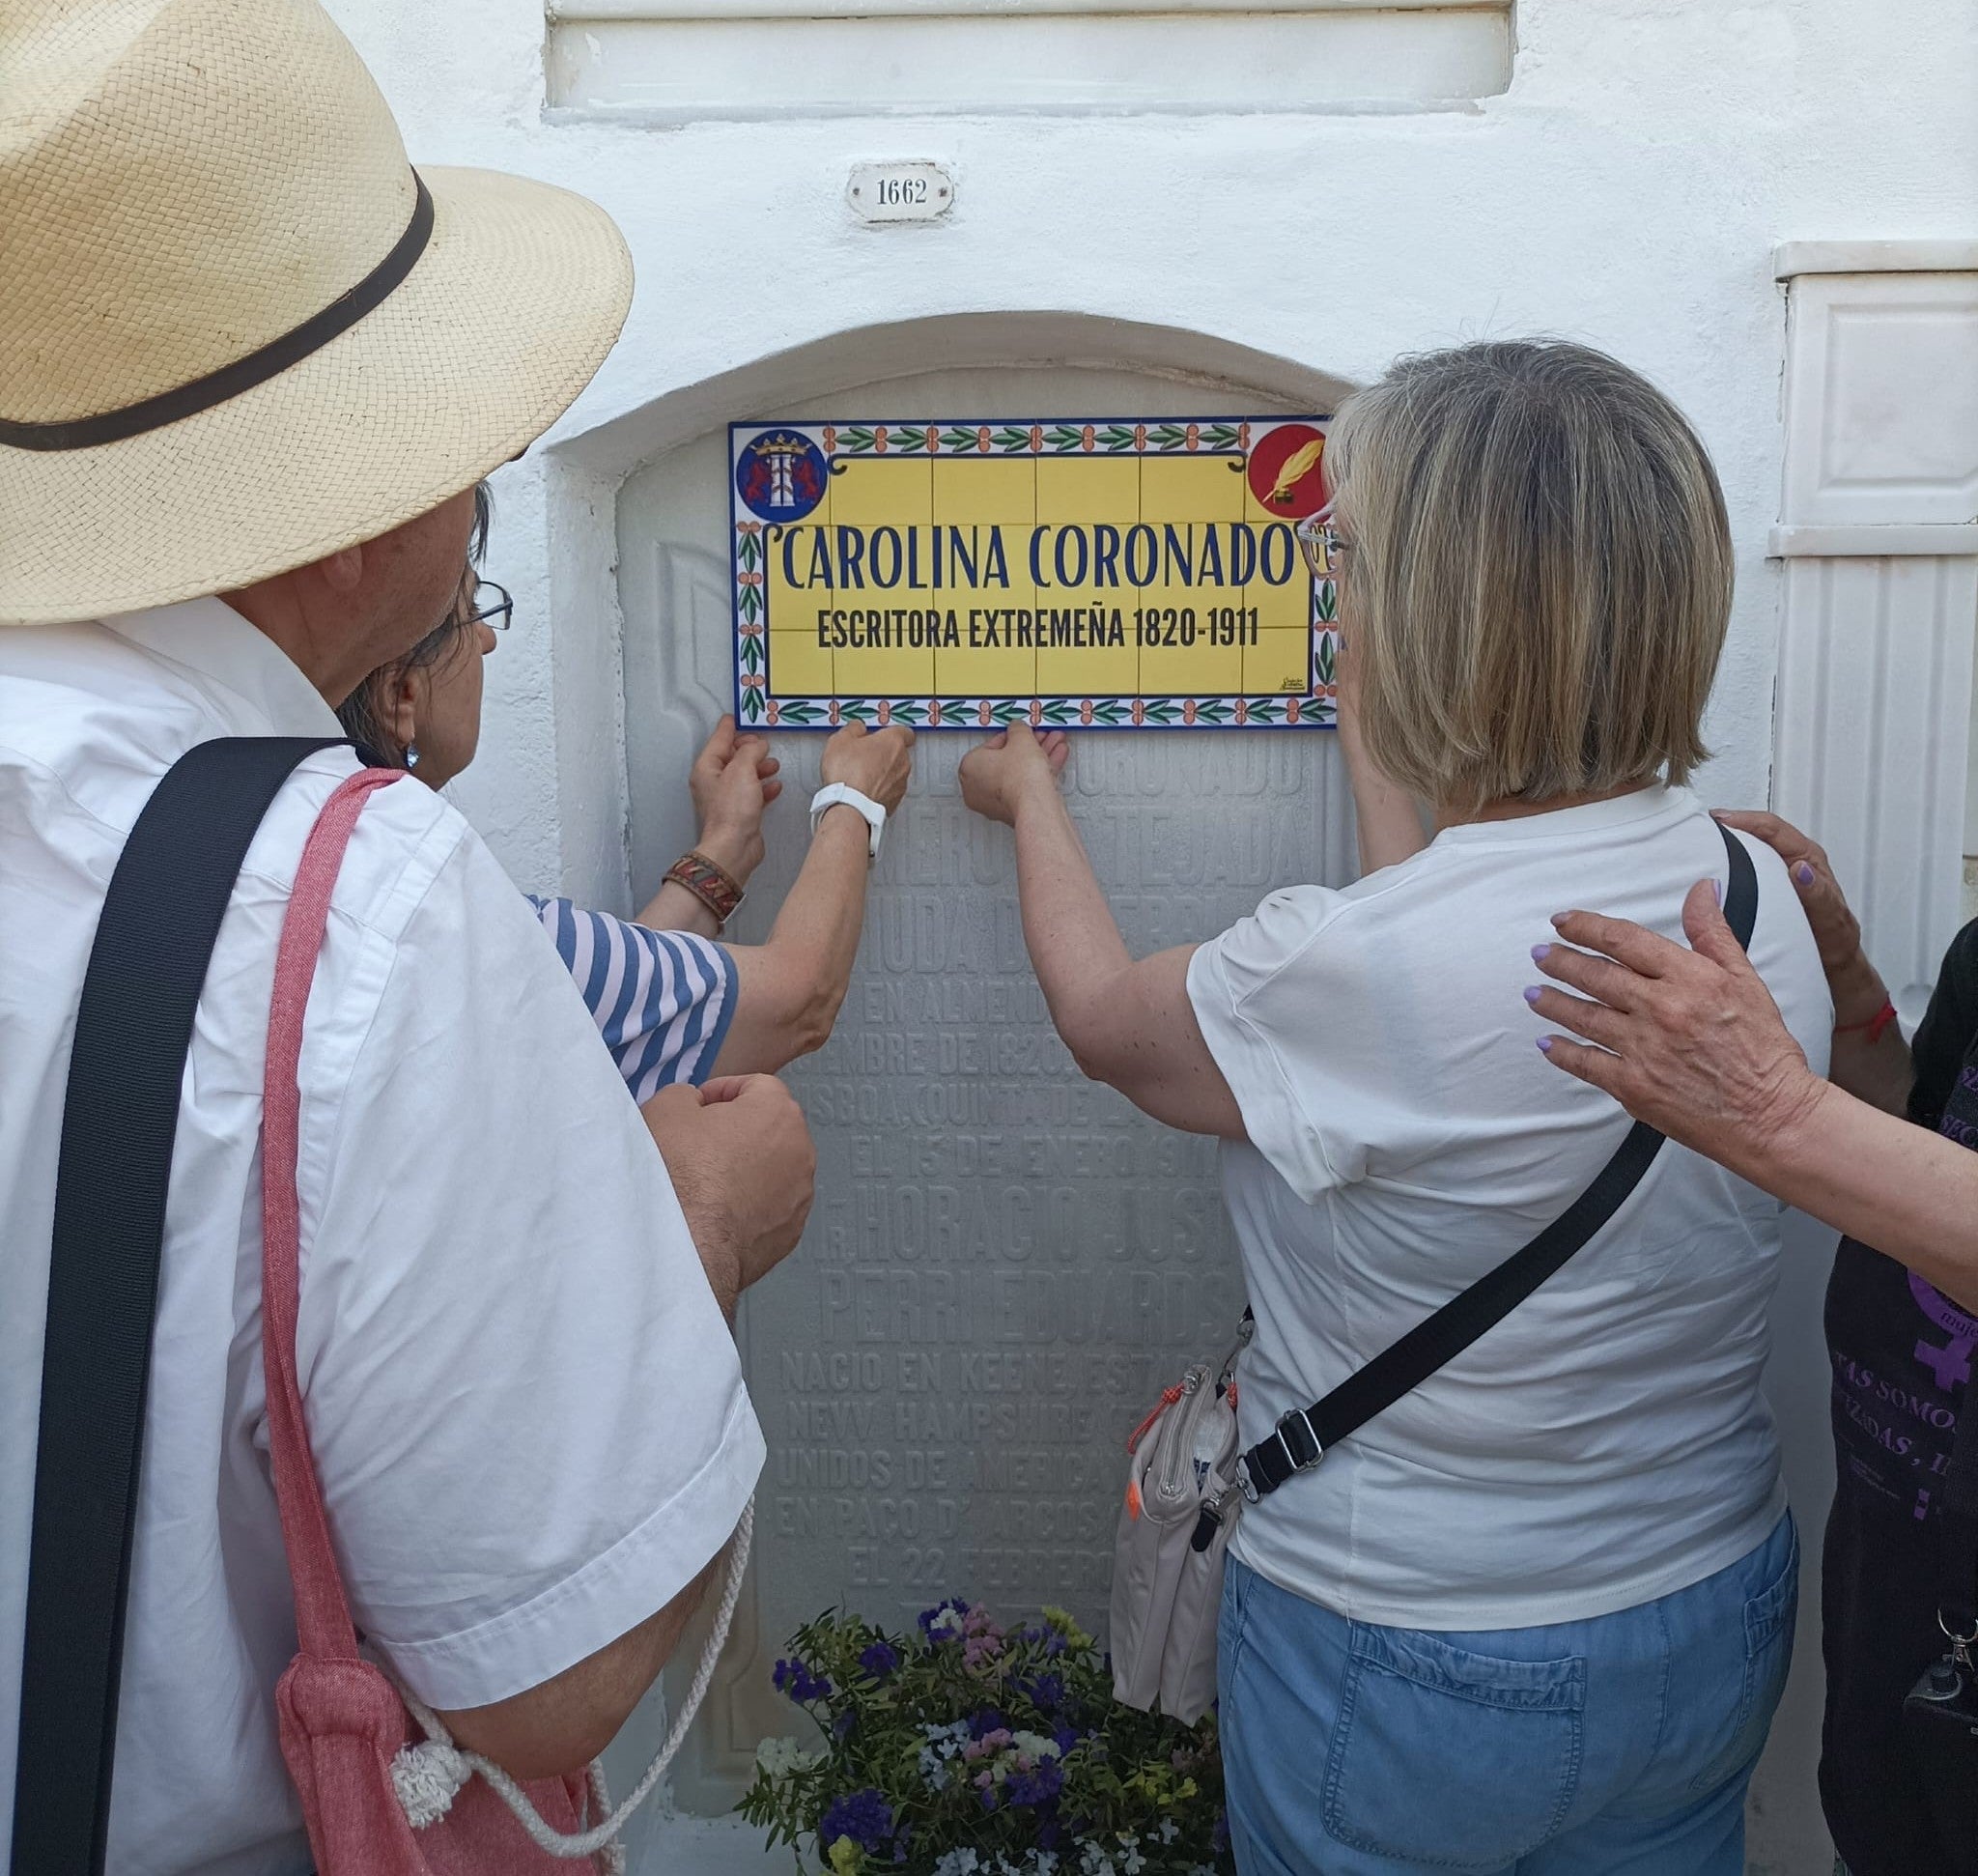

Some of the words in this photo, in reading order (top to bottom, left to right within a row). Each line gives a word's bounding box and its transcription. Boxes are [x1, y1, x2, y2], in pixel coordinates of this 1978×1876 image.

[877, 178, 927, 205] 1662
[782, 525, 1010, 590] CAROLINA
[1028, 523, 1294, 589] CORONADO
[817, 609, 960, 648] ESCRITORA
[969, 600, 1125, 648] EXTREMEÑA
[1132, 607, 1258, 647] 1820-1911
[1876, 1381, 1958, 1435] SOMO
